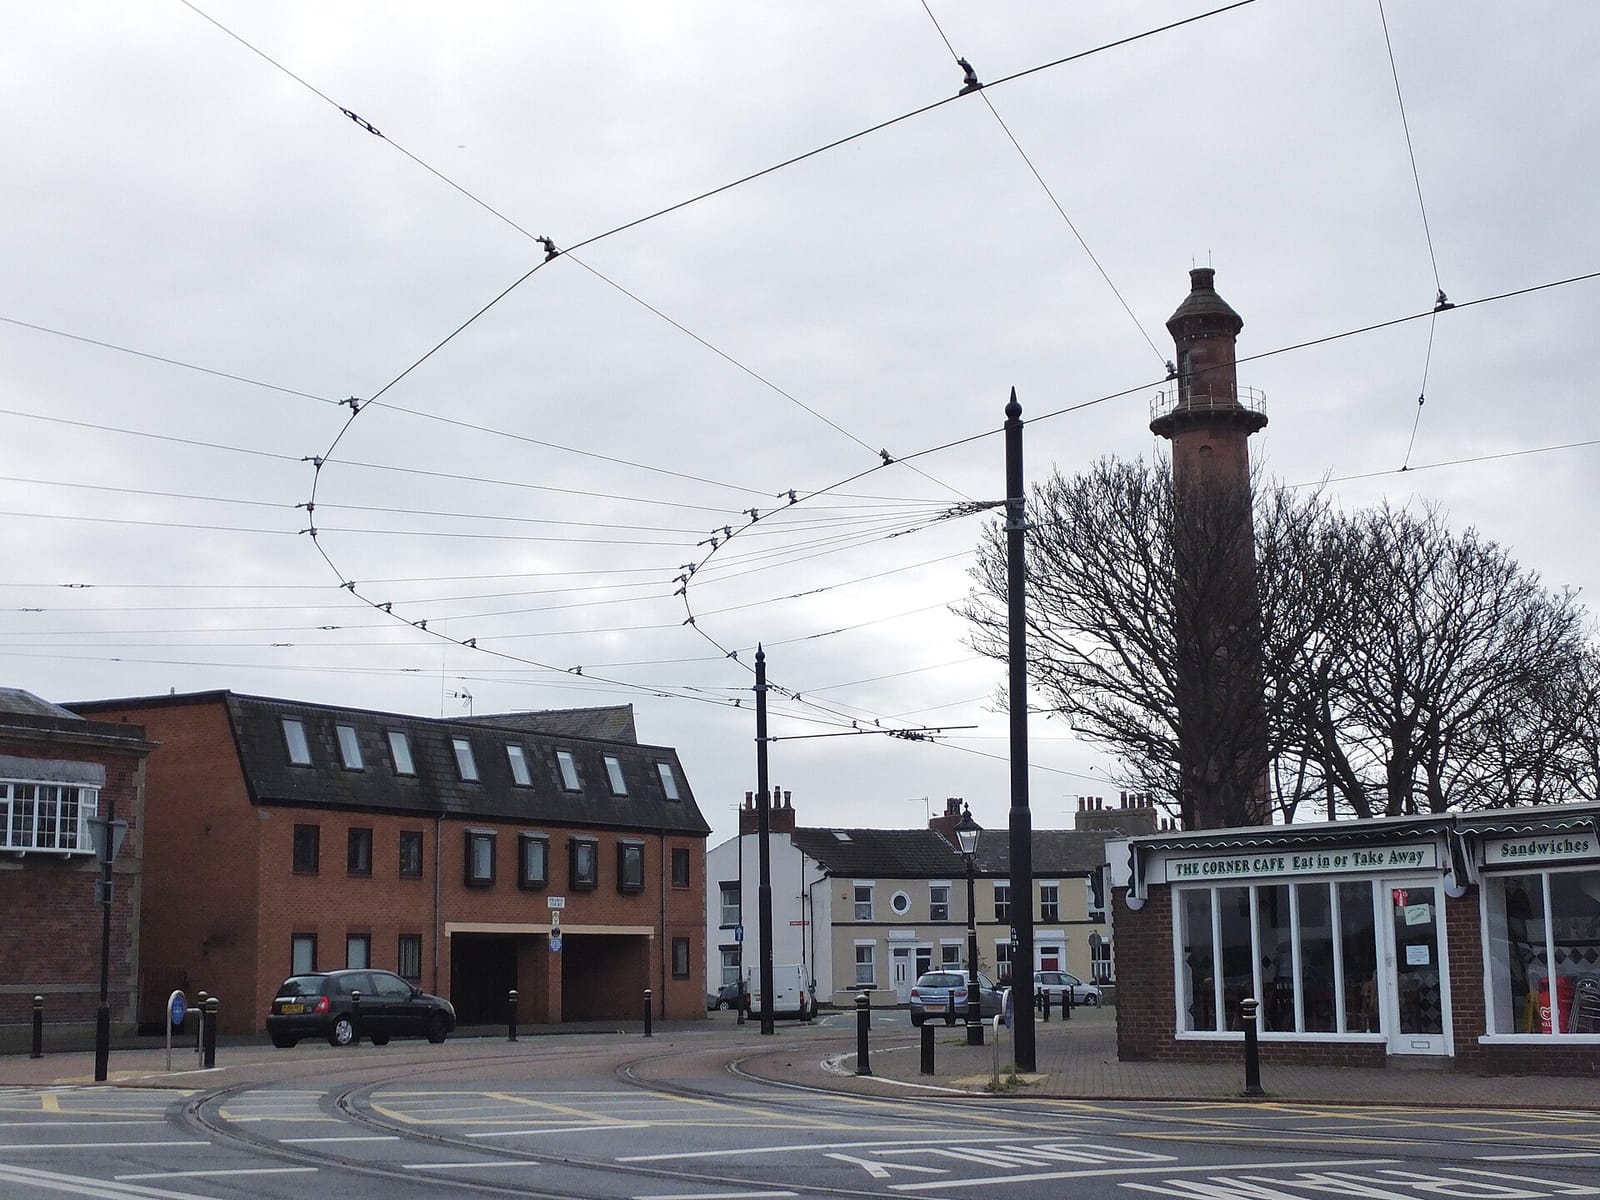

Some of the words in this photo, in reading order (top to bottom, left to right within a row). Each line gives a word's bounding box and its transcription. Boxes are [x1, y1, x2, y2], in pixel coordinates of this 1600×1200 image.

[1501, 839, 1589, 857] Sandwiches
[1175, 863, 1199, 876] THE
[1203, 859, 1250, 875] CORNER
[1253, 857, 1285, 873] CAFE
[1293, 856, 1314, 870] Eat
[1317, 854, 1330, 868] in
[1334, 855, 1348, 867] or
[1352, 851, 1384, 866] Take
[1388, 850, 1424, 866] Away
[823, 1144, 1178, 1178] ONLY
